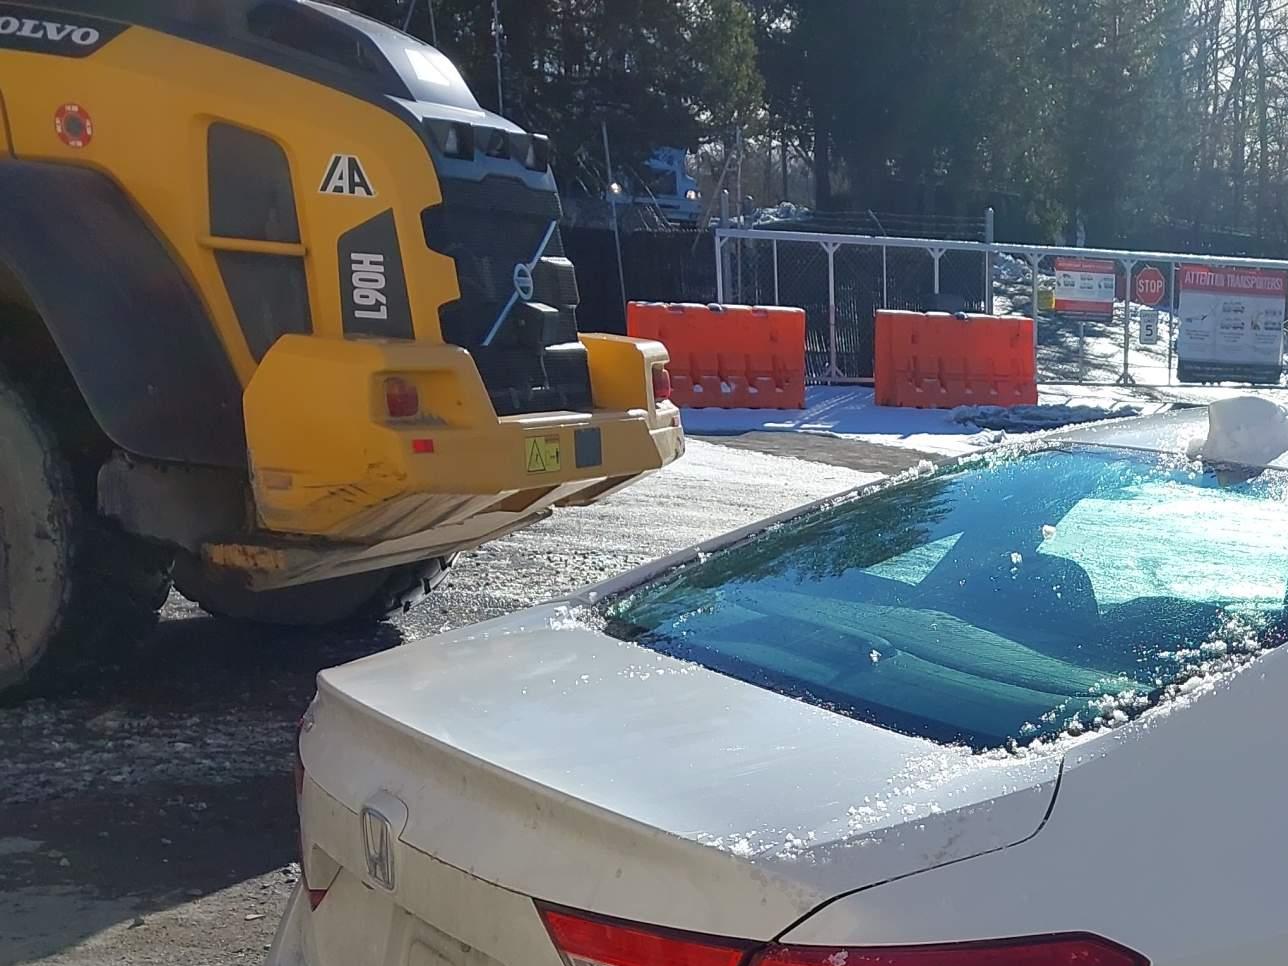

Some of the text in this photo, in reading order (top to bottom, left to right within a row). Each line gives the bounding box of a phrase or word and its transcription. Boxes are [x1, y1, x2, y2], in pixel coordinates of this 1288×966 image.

[0, 16, 100, 46] OLVO
[350, 252, 388, 320] L90H
[1138, 279, 1163, 294] STOP
[1145, 324, 1153, 337] 5
